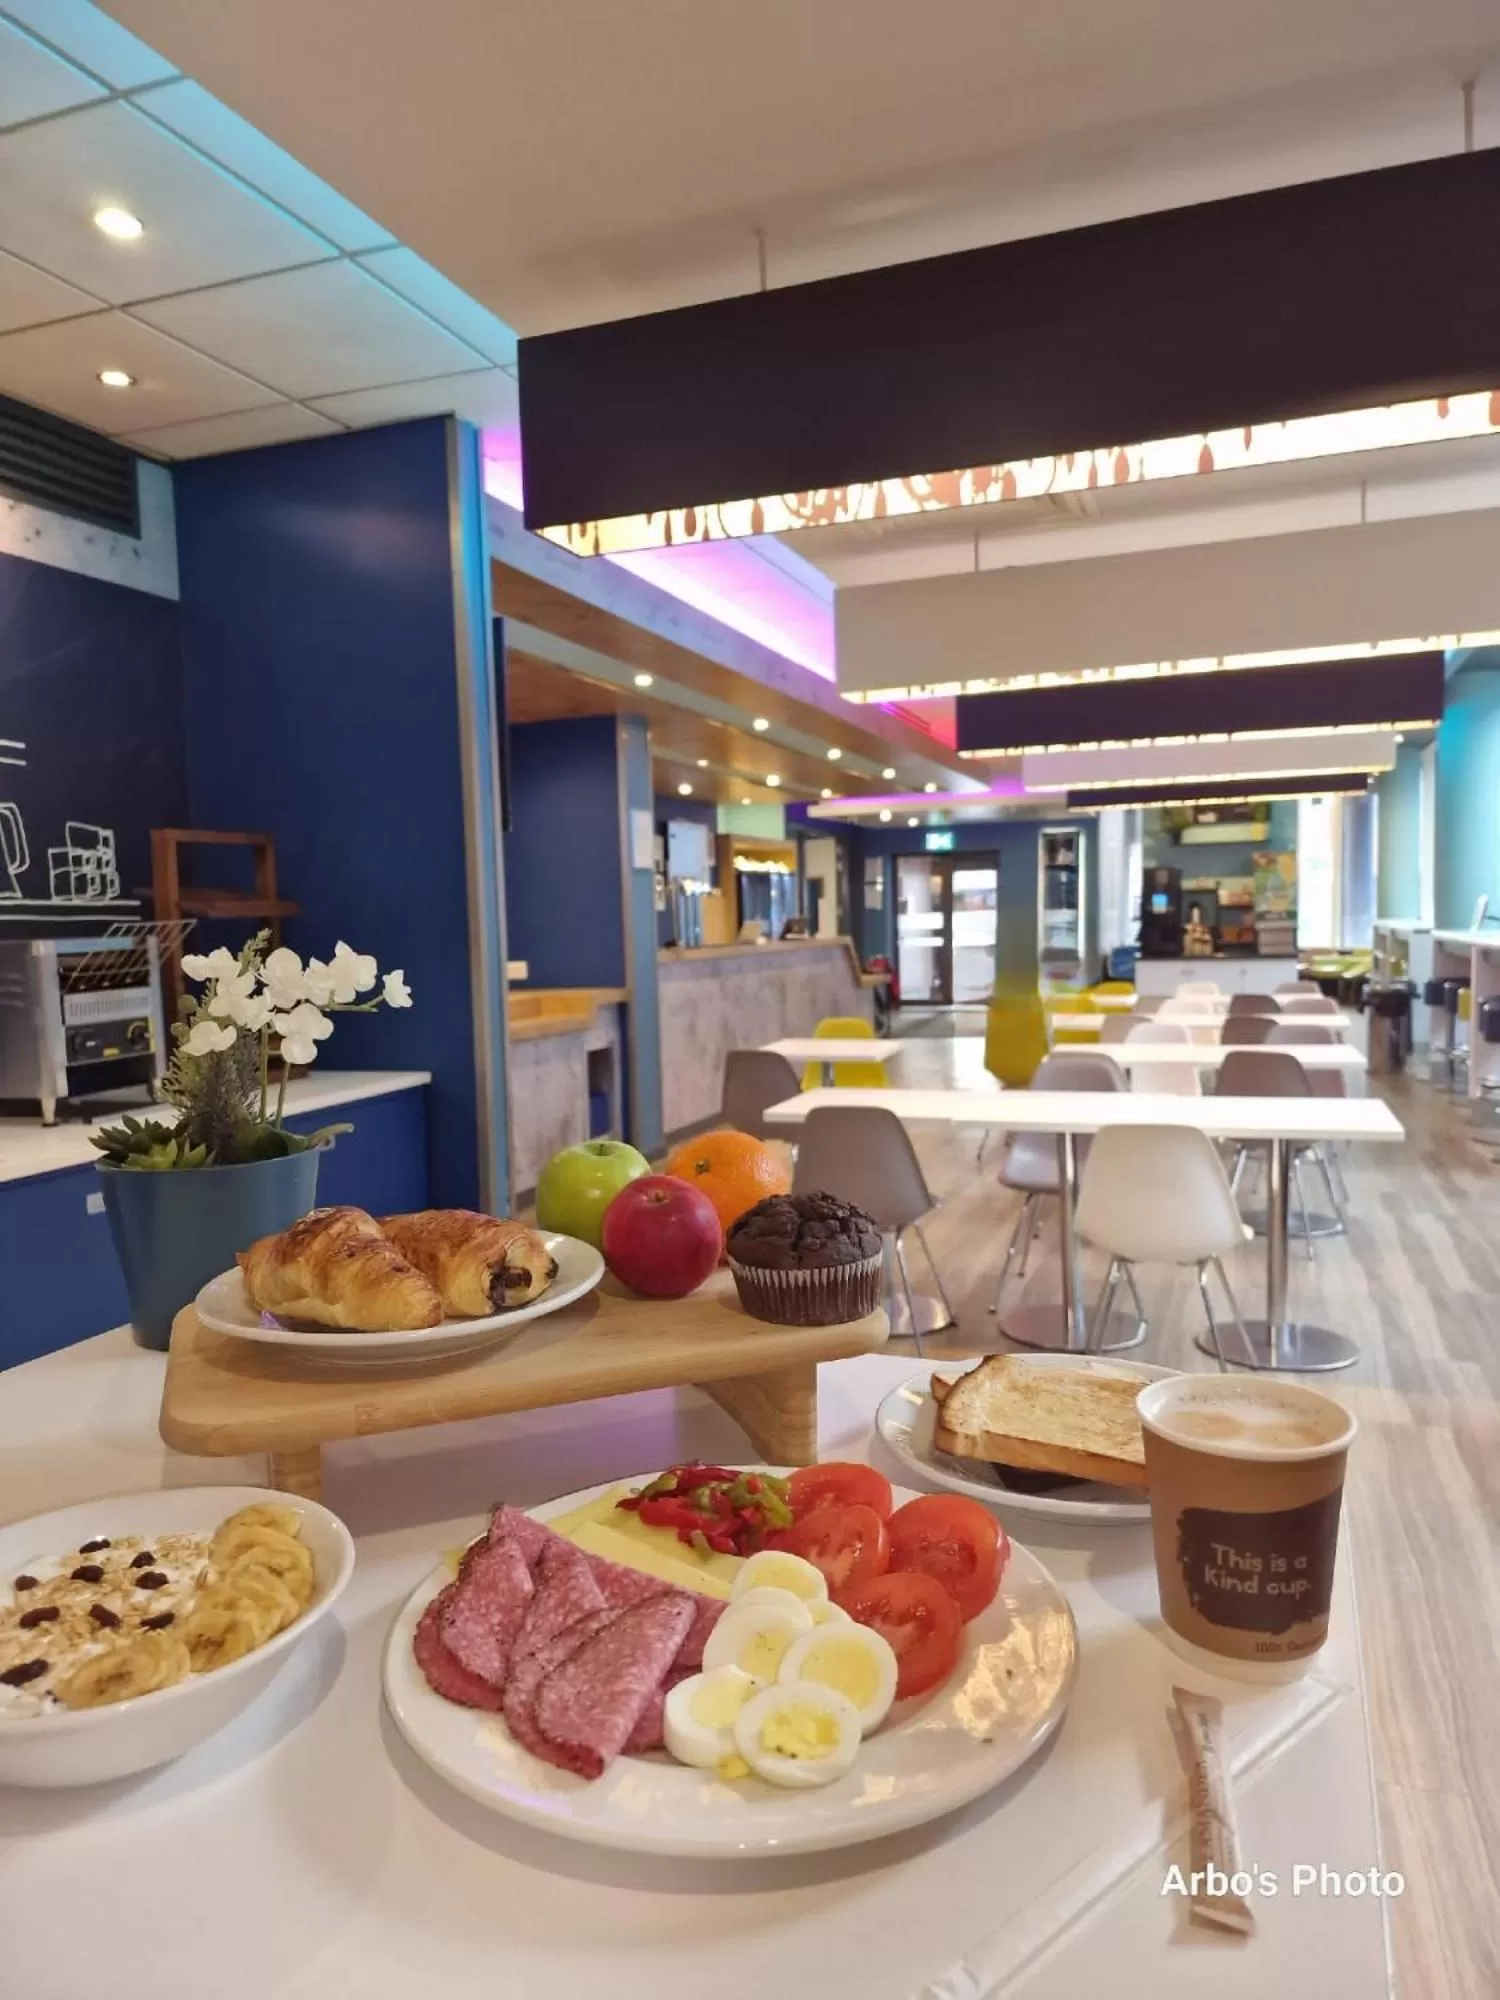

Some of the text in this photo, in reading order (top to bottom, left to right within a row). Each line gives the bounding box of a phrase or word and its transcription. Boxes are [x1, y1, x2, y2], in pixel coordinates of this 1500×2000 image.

[1210, 1542, 1308, 1573] This is a
